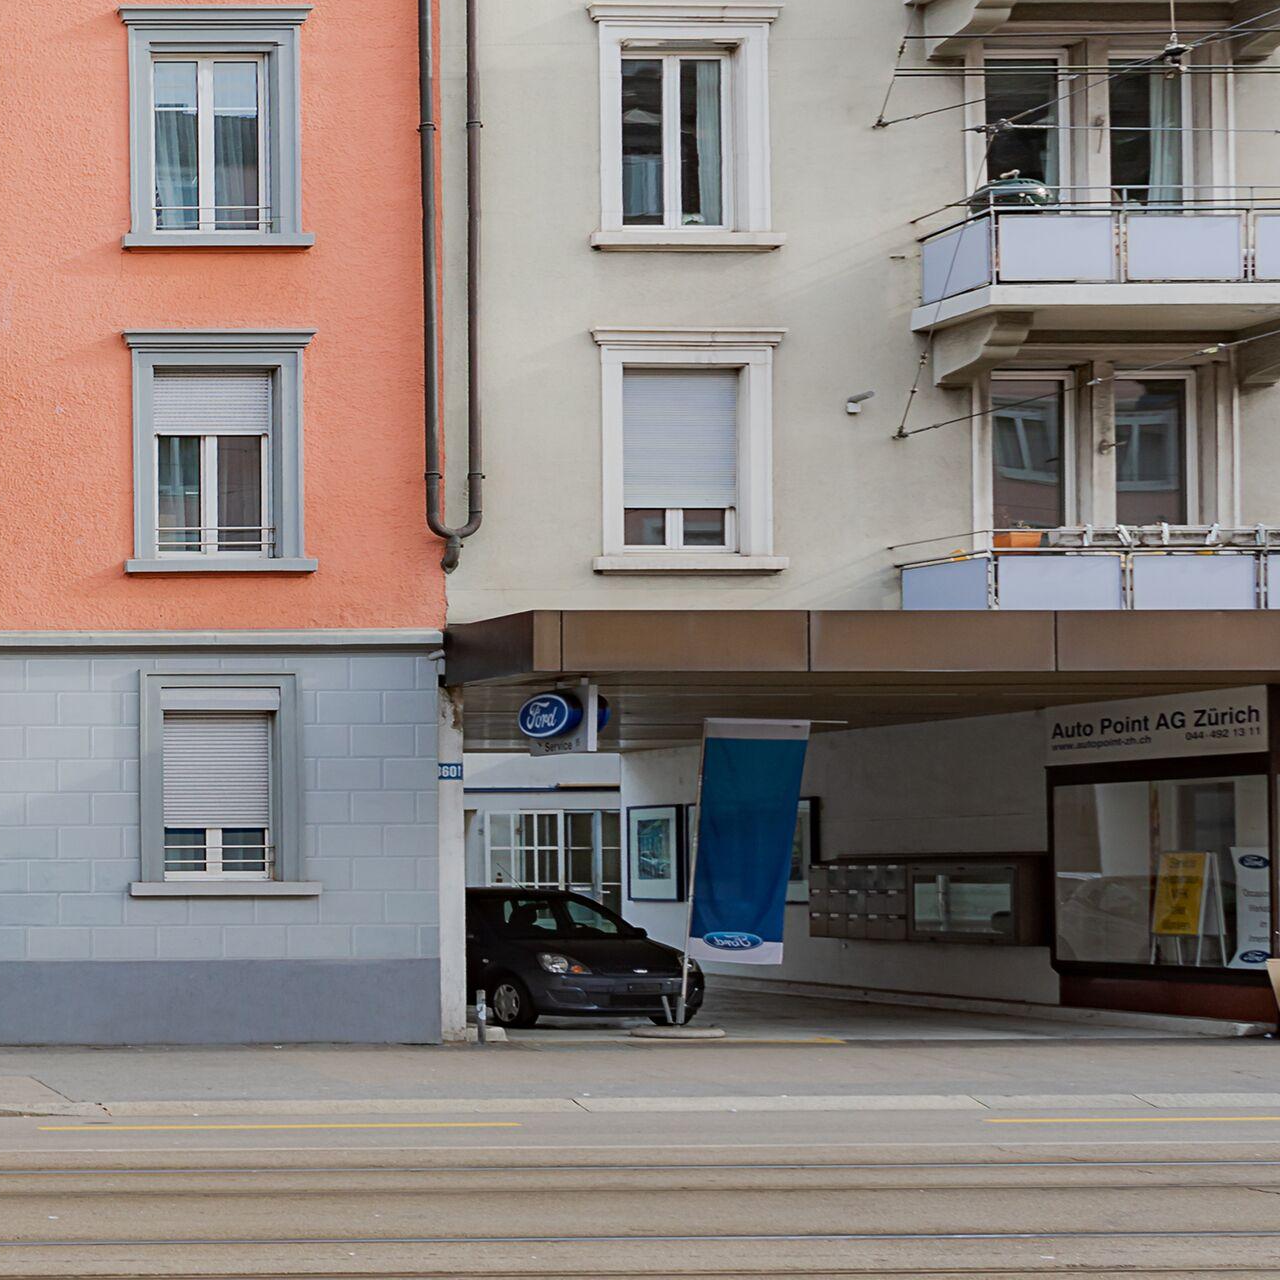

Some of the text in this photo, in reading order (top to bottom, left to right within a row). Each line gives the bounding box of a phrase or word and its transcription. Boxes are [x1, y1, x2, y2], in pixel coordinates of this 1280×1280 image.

[526, 701, 557, 730] Ford
[1051, 705, 1260, 739] Auto Point AG Zürich
[1051, 735, 1152, 751] www.autopoint-zh.ch
[1233, 727, 1246, 738] 13
[1249, 726, 1261, 736] 11
